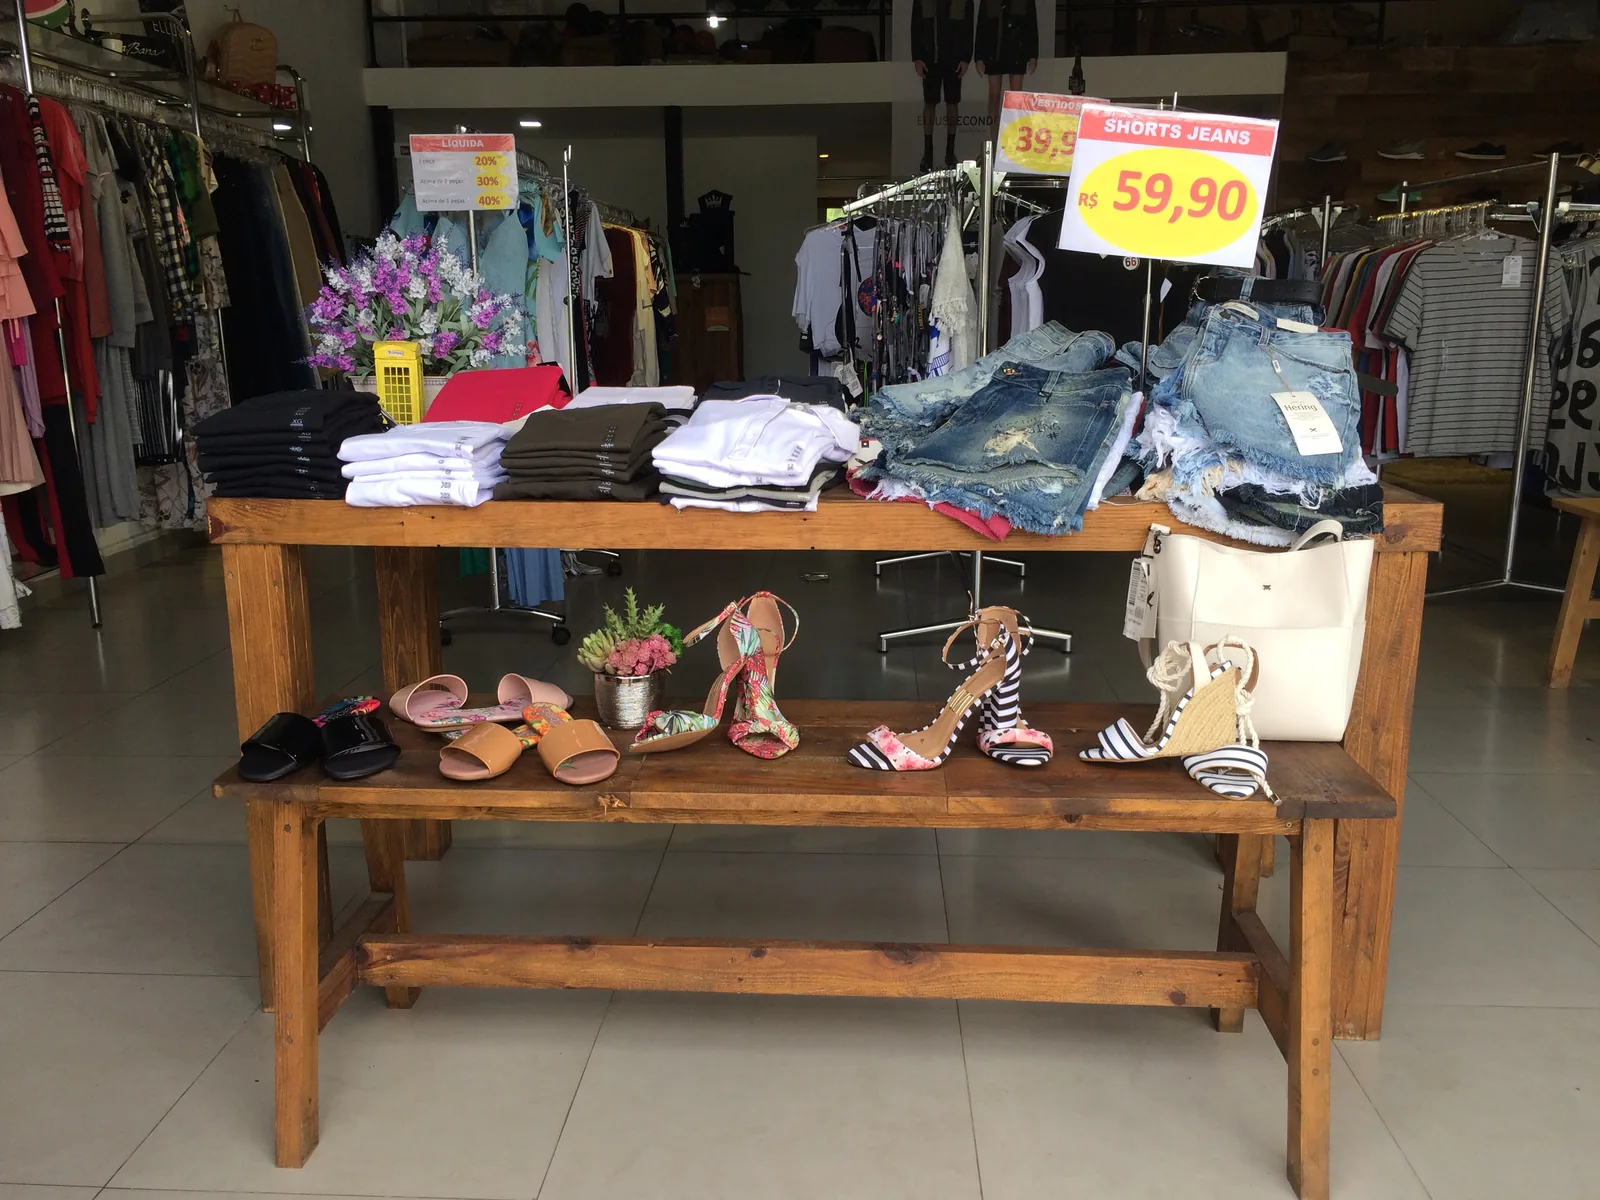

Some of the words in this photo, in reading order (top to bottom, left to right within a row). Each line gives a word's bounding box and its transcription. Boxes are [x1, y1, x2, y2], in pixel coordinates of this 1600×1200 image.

[1031, 96, 1081, 110] VESTIDOS
[1104, 118, 1181, 139] SHORTS
[1187, 126, 1250, 145] JEANS
[442, 139, 484, 148] LIQUIDA
[475, 156, 497, 166] 20%
[477, 176, 499, 186] 30%
[479, 196, 501, 206] 40%
[1078, 191, 1099, 209] R$
[1113, 170, 1248, 224] 59,90
[1124, 256, 1138, 268] 66
[1283, 403, 1318, 412] Hering
